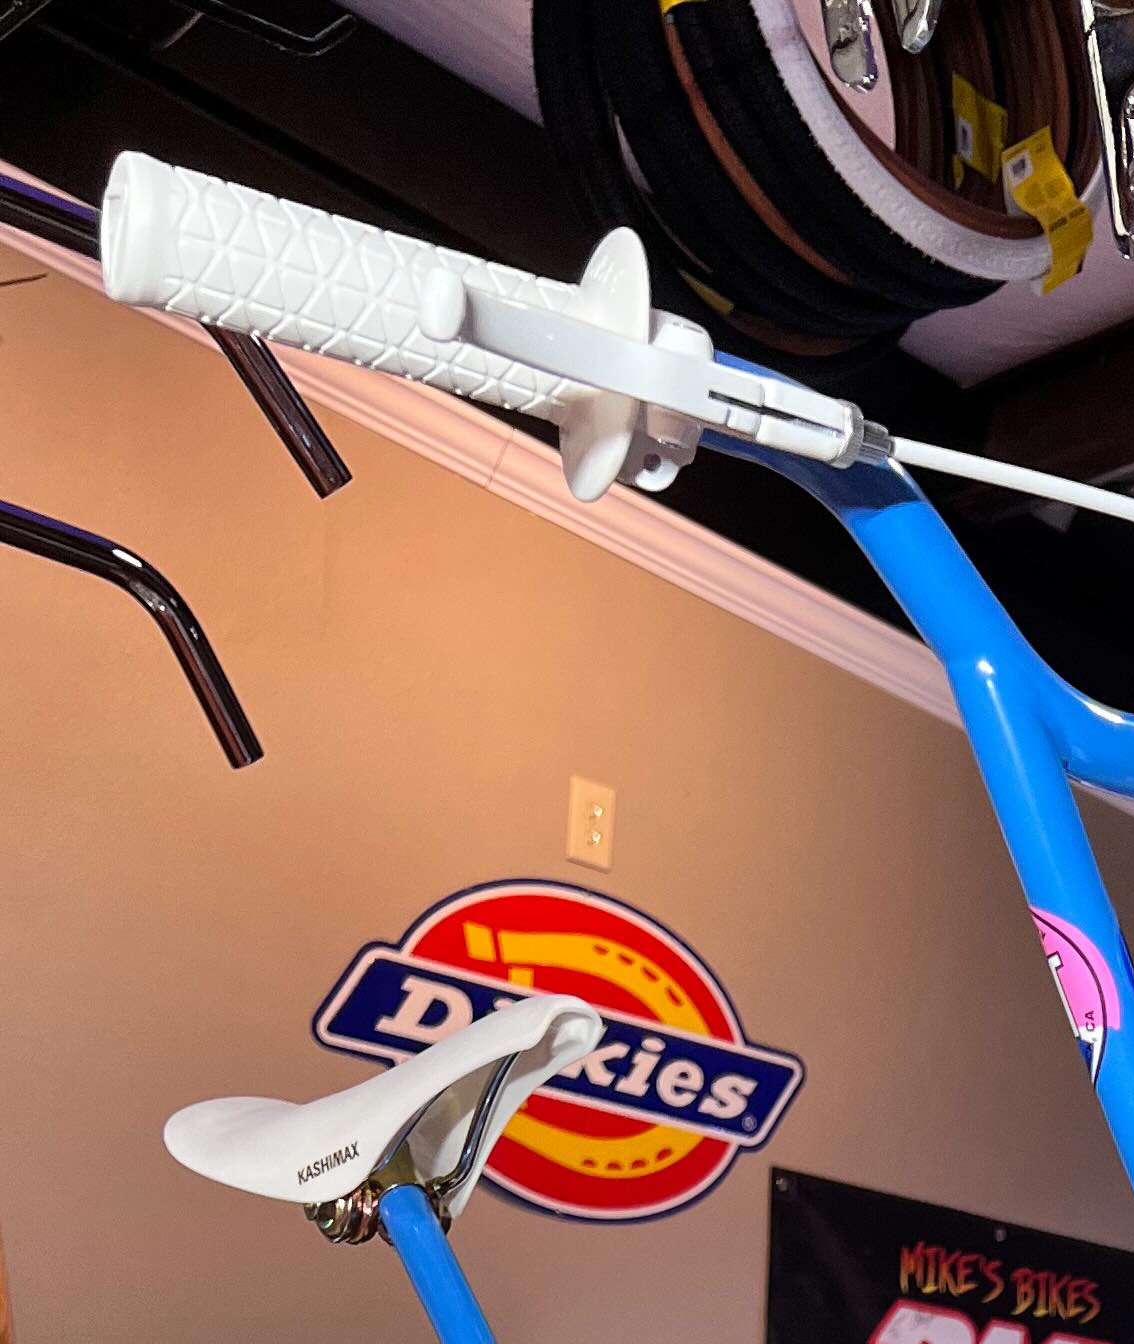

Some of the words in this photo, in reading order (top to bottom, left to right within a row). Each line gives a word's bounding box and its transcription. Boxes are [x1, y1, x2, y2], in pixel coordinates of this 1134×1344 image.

[374, 973, 760, 1121] Dkies
[296, 1141, 361, 1187] KASHIMAX
[899, 1241, 1005, 1302] MIKE'S
[1009, 1266, 1102, 1325] BIKES
